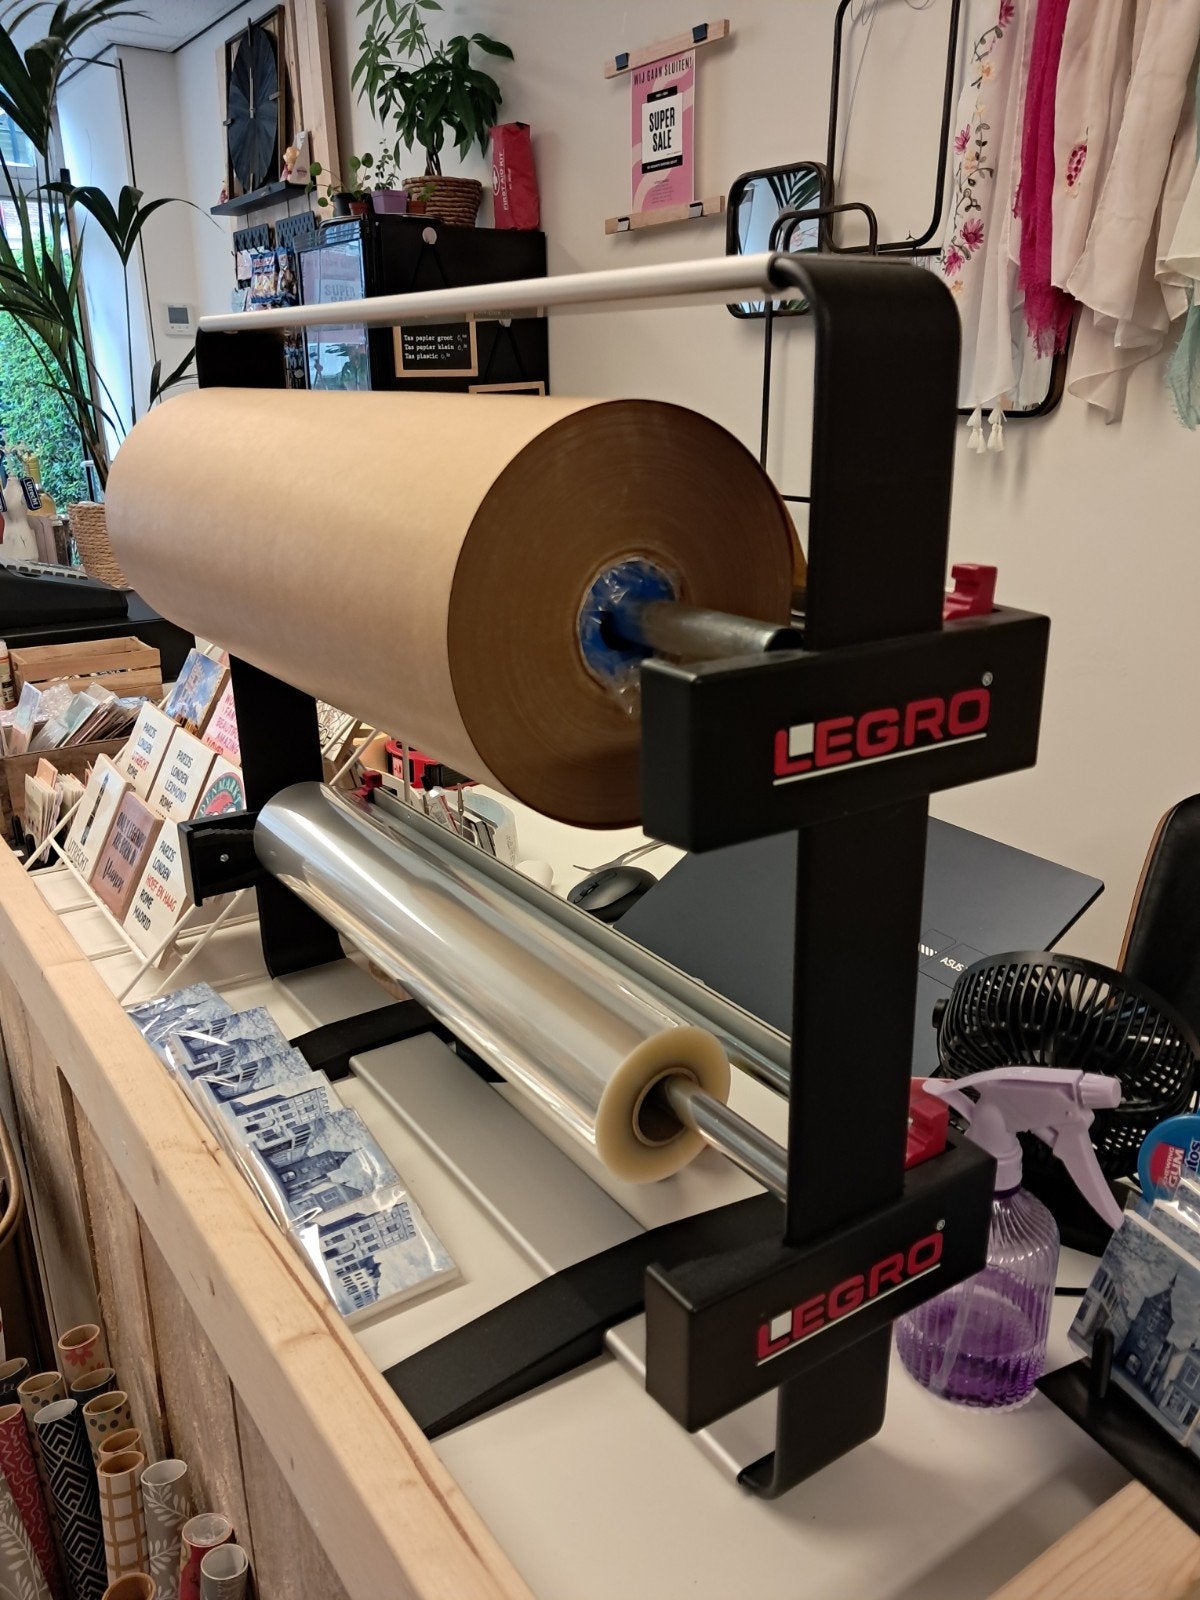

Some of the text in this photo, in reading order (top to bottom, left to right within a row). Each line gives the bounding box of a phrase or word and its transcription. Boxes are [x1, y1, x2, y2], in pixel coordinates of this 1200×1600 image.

[647, 66, 662, 82] GAAN
[649, 107, 675, 132] SUPER
[652, 130, 672, 152] SALE
[500, 186, 508, 210] FIRST
[26, 481, 39, 506] Utrecht
[774, 688, 991, 776] LEGRO
[170, 765, 189, 786] LONDEN
[159, 794, 172, 812] ROME
[152, 857, 172, 882] LONDEN
[140, 889, 154, 910] ROME
[162, 890, 178, 912] HAAG
[132, 906, 152, 932] MADRID
[940, 957, 965, 972] ASUS
[1162, 1147, 1174, 1186] CHEWING
[1168, 1148, 1185, 1188] GUM
[758, 1232, 944, 1359] LEGRO
